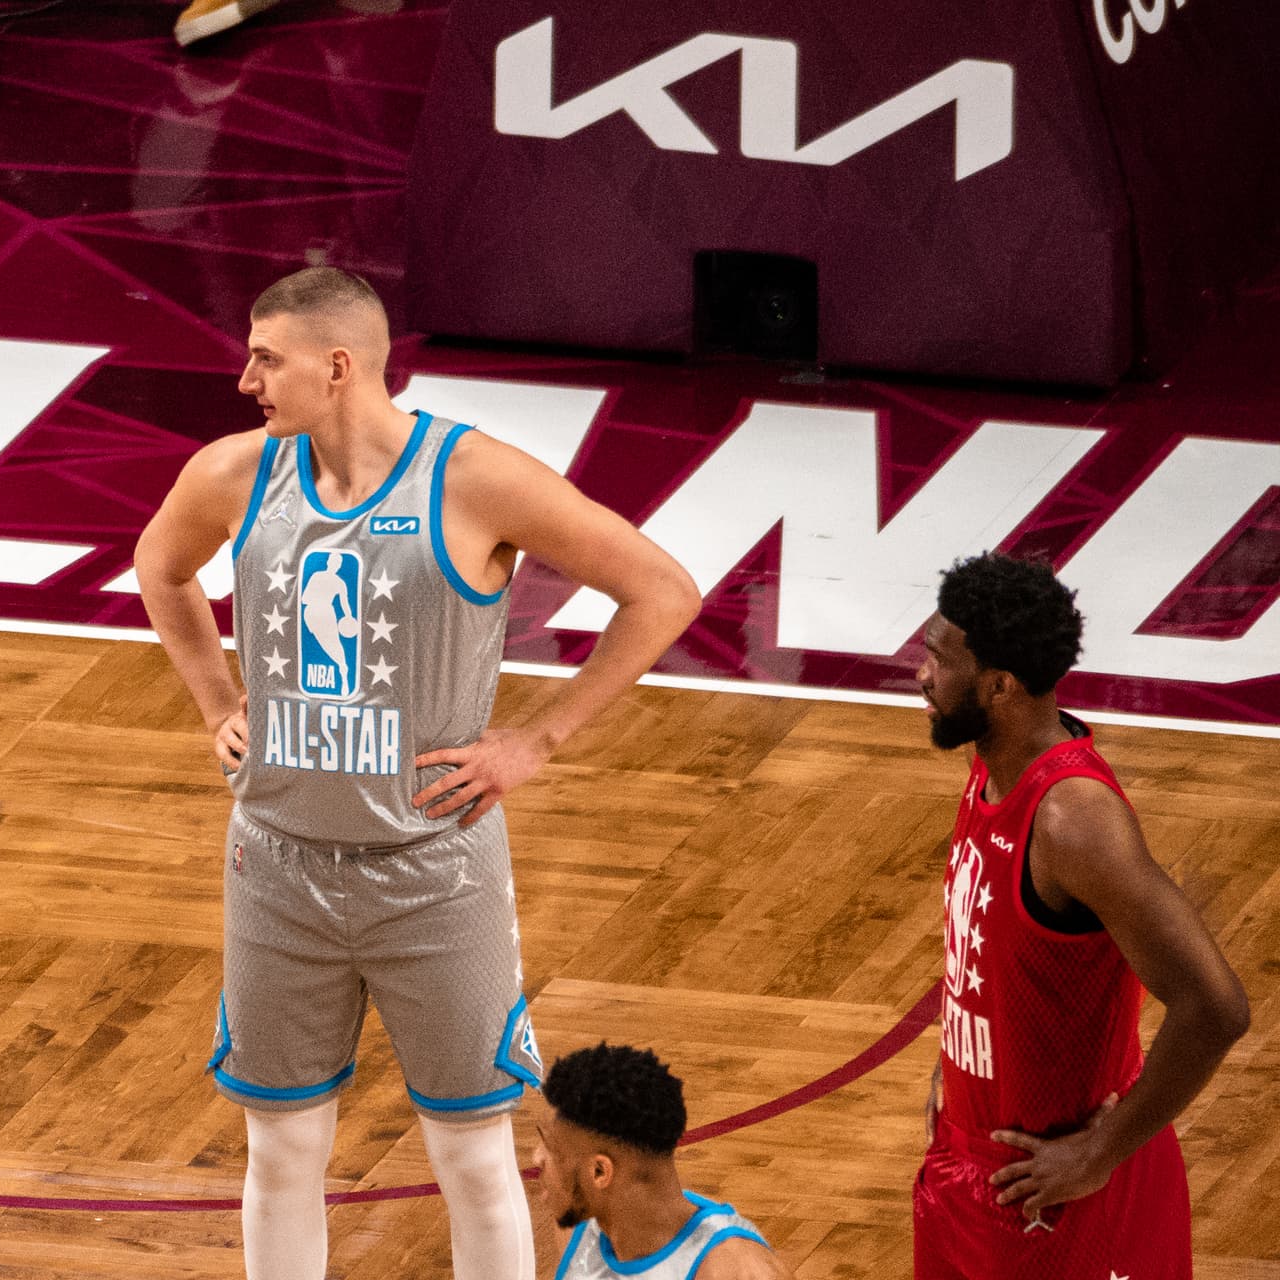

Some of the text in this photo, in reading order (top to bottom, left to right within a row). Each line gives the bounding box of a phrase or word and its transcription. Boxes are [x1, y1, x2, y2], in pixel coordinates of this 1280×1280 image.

[496, 17, 1013, 181] KIA
[374, 520, 416, 531] KIA
[307, 663, 336, 689] NBA
[265, 700, 401, 775] ALL-STAR
